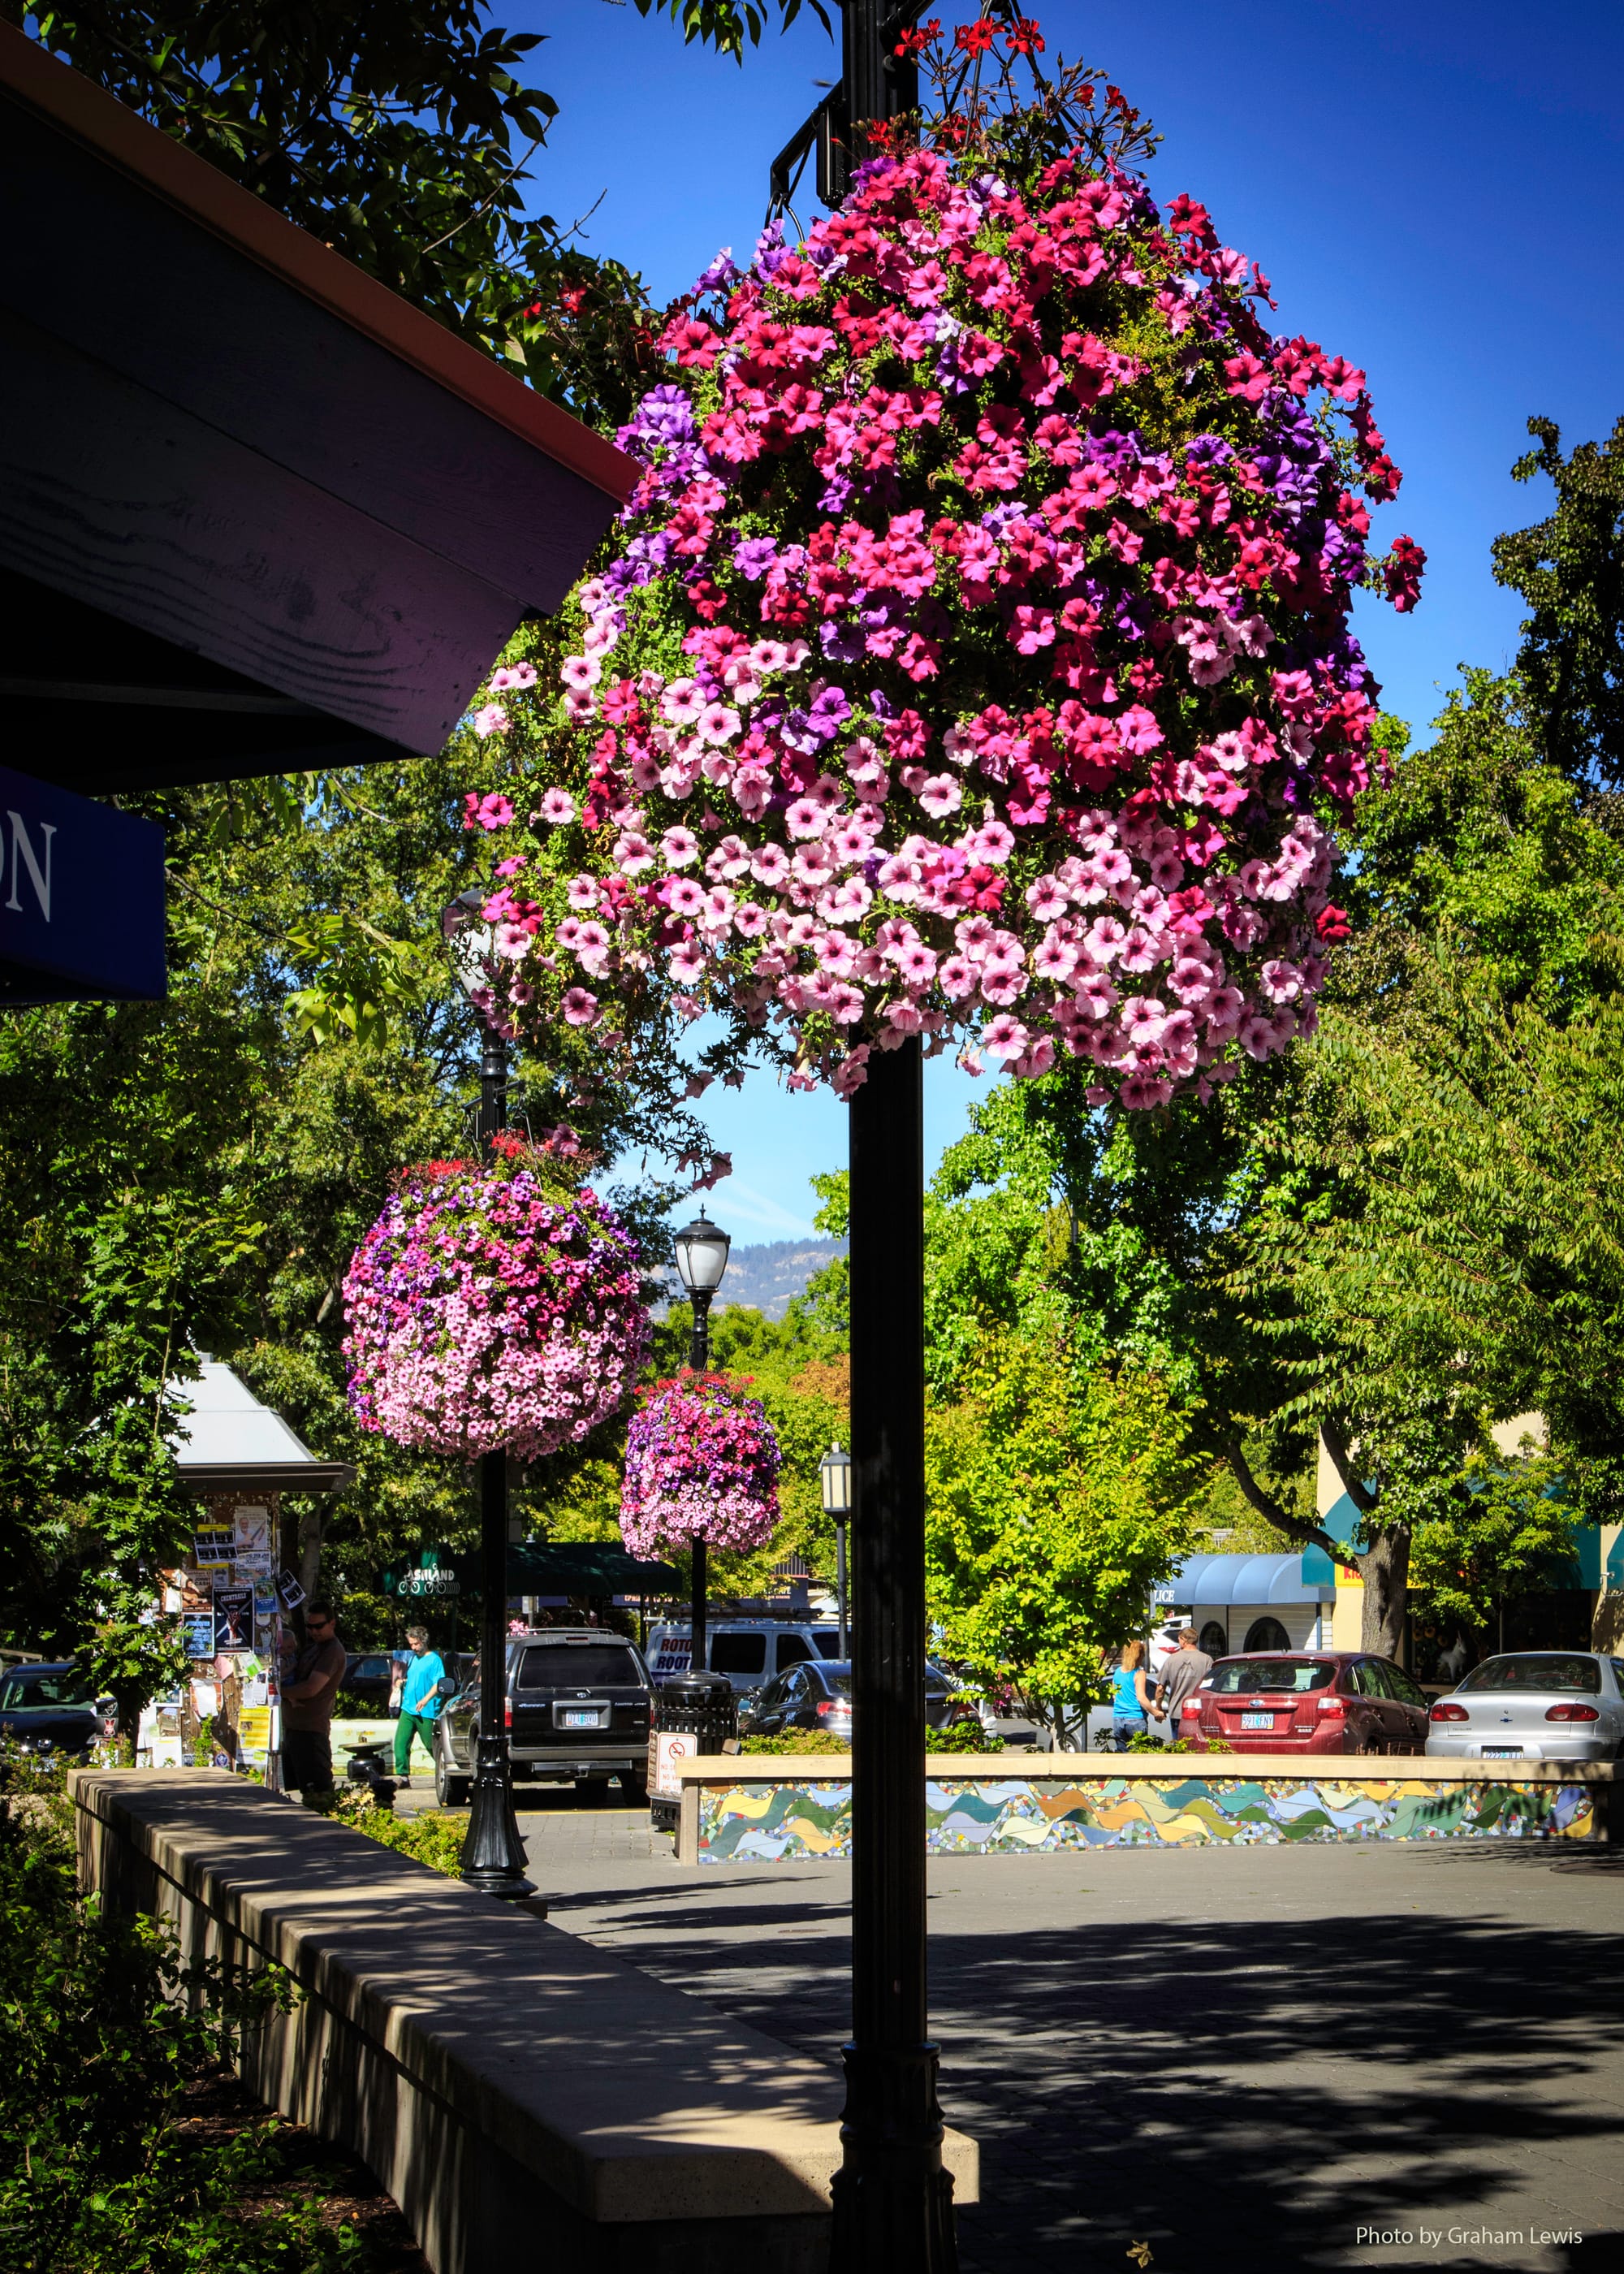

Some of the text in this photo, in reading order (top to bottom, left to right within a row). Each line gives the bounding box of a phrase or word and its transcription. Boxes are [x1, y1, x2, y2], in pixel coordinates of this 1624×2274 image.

[0, 810, 57, 923] N
[406, 1569, 455, 1582] ASHLAND
[1153, 1589, 1176, 1602] LICE
[656, 1655, 693, 1670] ROOT
